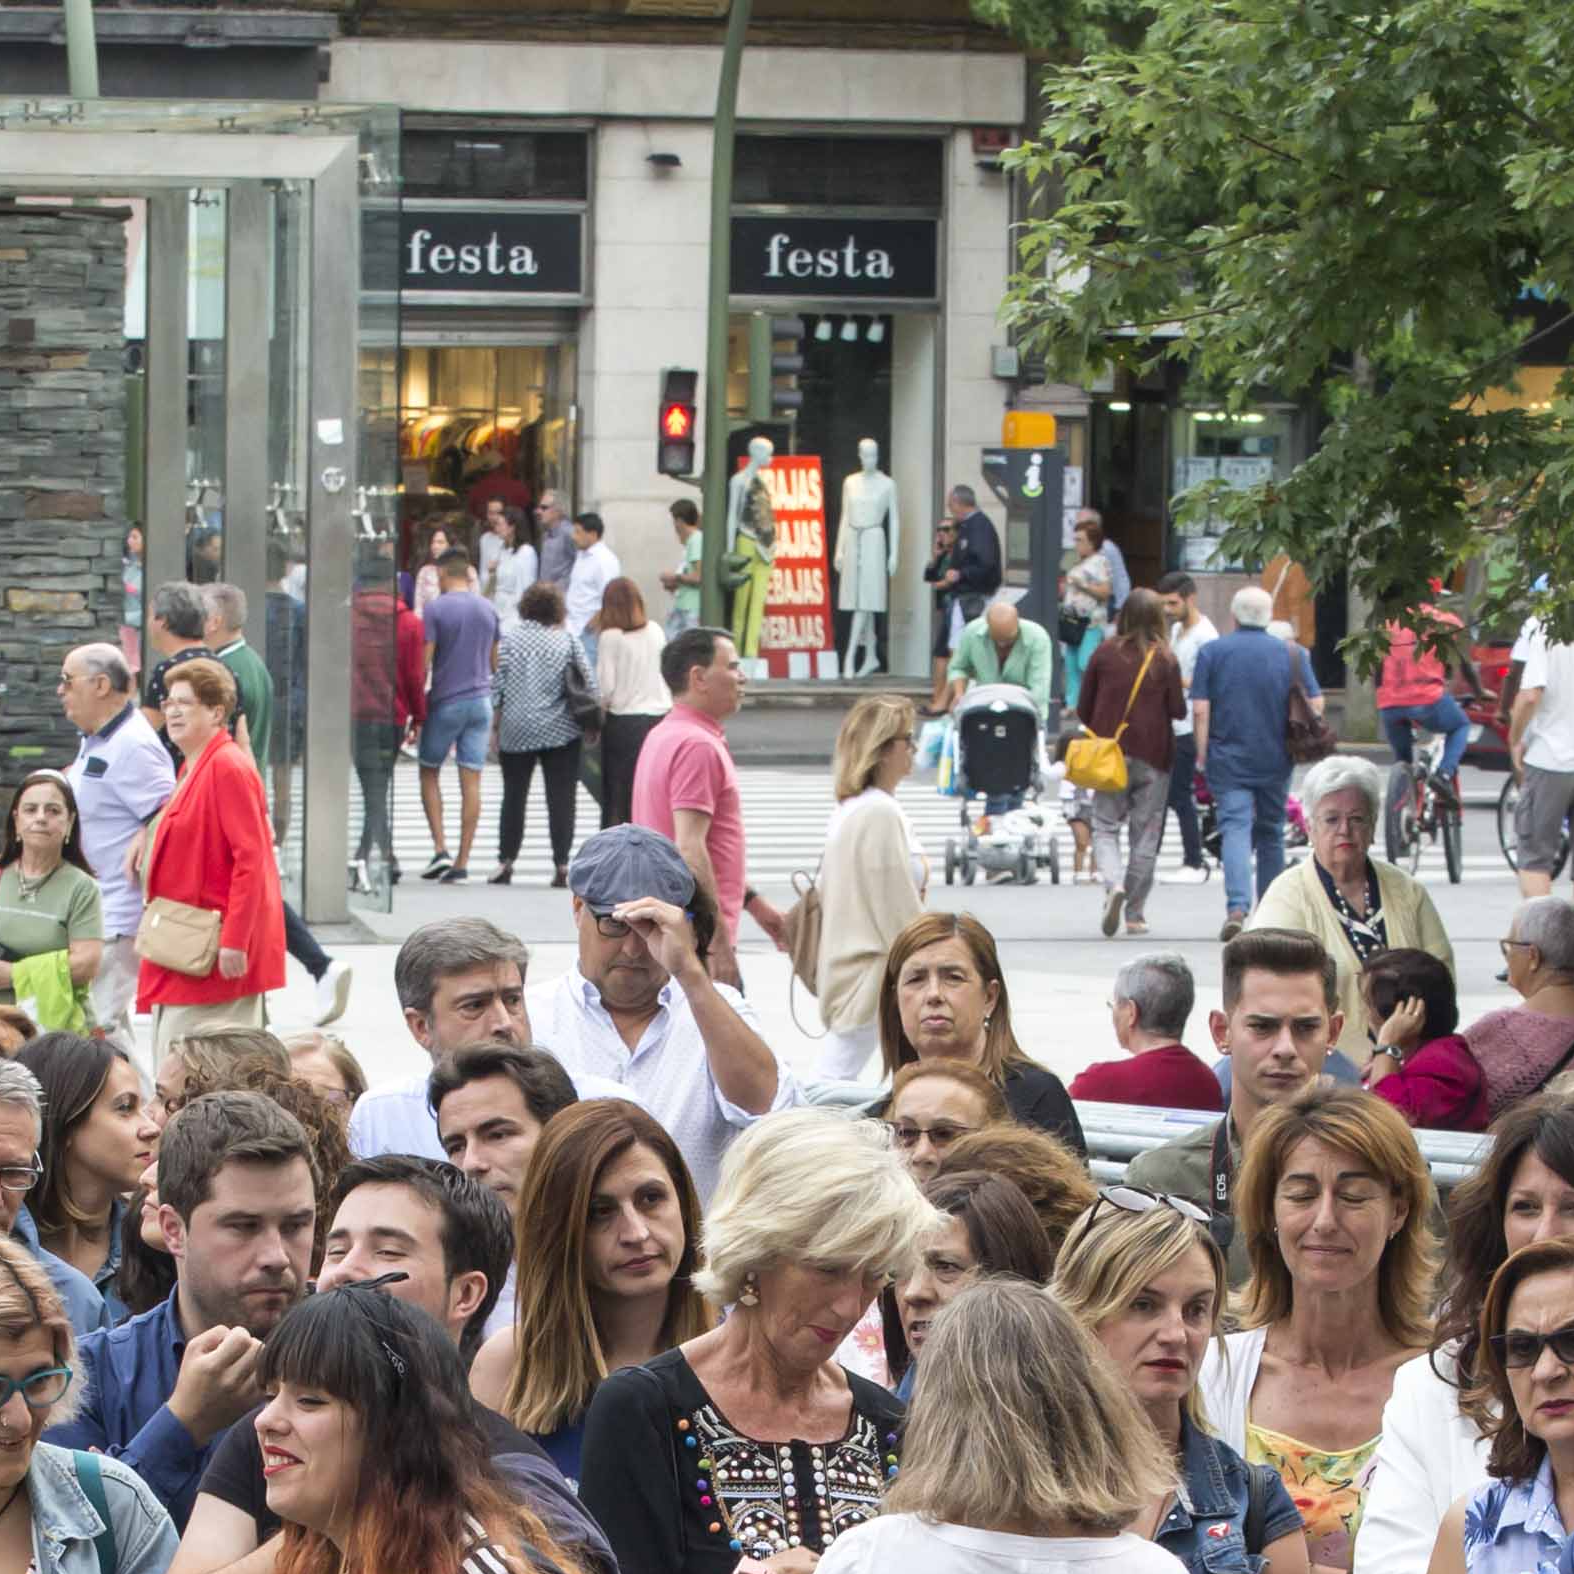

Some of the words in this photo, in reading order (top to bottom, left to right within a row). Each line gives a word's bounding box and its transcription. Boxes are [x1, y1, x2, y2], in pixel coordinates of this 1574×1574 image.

[404, 229, 538, 275] festa
[763, 234, 895, 279] festa
[760, 468, 822, 511] BAJAS
[775, 519, 824, 559] AJAS
[766, 567, 825, 606] EBAJAS
[1216, 1173, 1226, 1200] EOS
